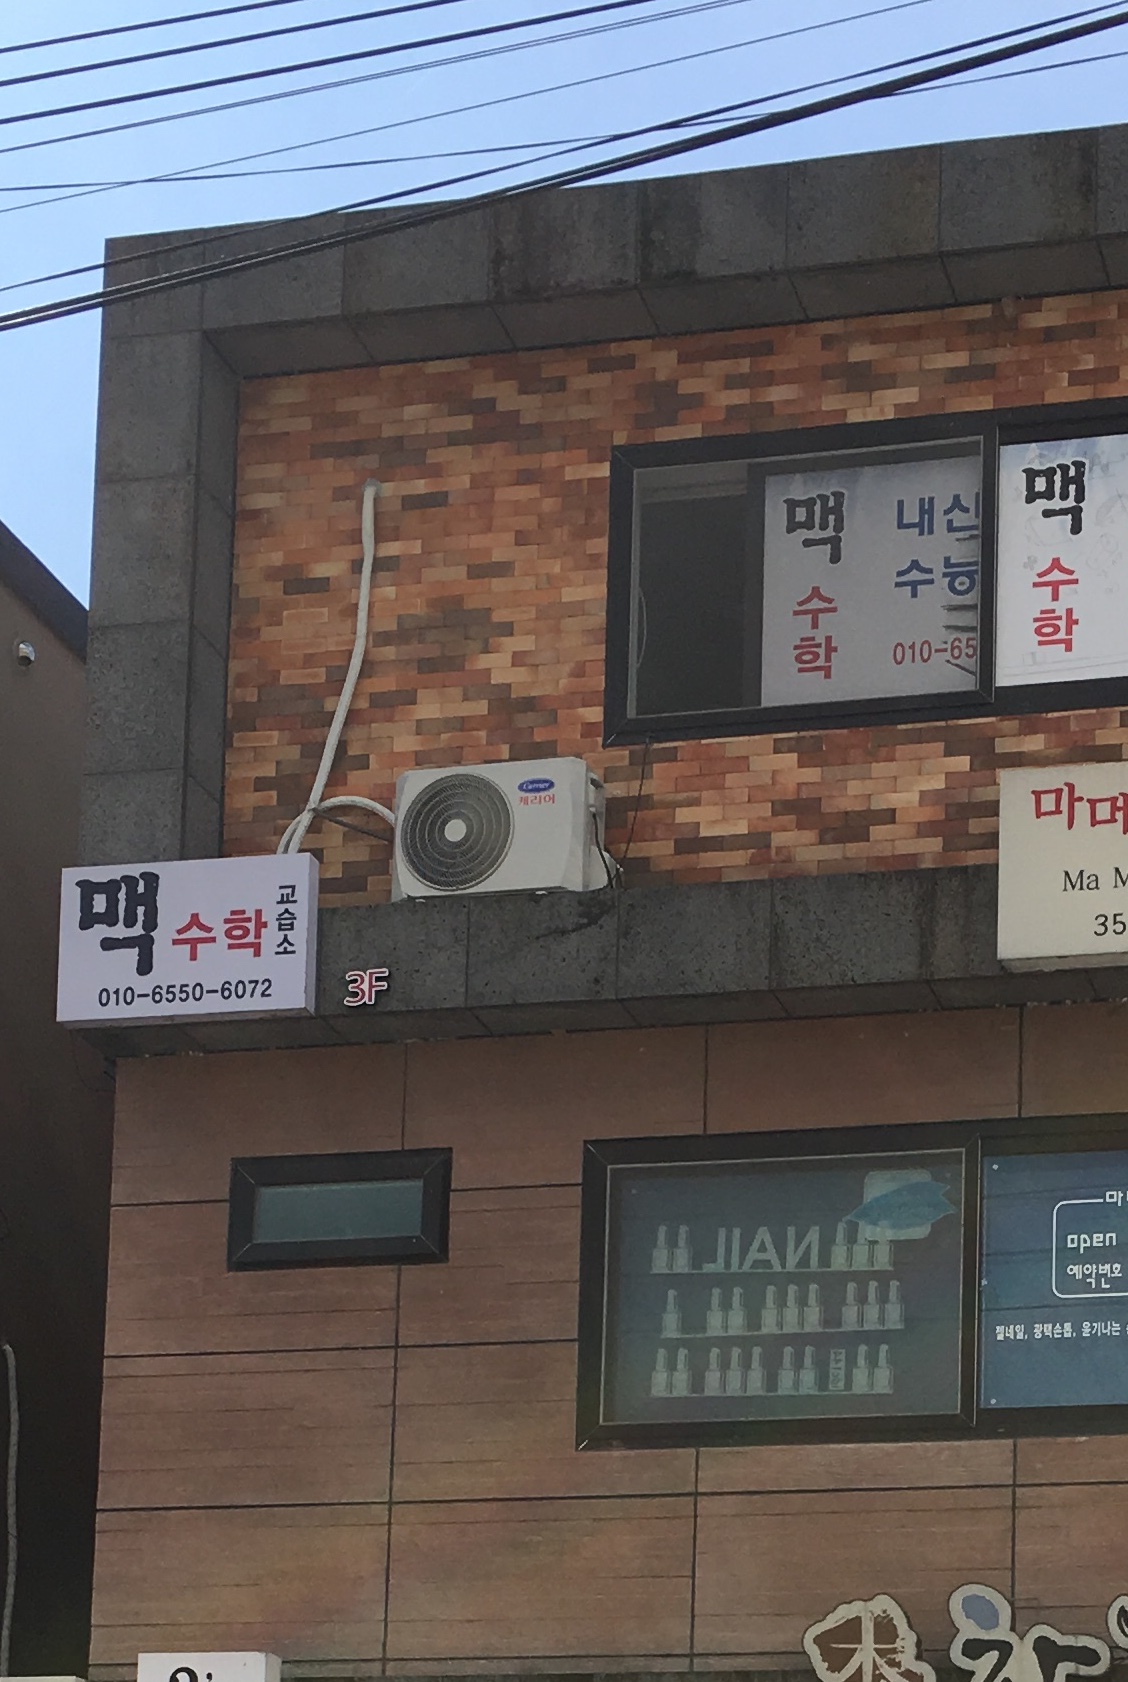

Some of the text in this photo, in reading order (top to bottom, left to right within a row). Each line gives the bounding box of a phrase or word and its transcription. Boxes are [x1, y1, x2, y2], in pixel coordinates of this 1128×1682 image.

[783, 490, 847, 564] 맥
[895, 493, 979, 537] 내신
[1021, 460, 1088, 536] 맥
[893, 556, 979, 599] 수능
[1032, 556, 1080, 654] 수학
[792, 585, 839, 680] 수학
[1062, 868, 1100, 893] Ma
[75, 871, 269, 976] 맥 수학
[274, 884, 299, 957] 교습소
[98, 978, 273, 1008] 010-6550-6072
[344, 968, 389, 1006] 3F
[1066, 1262, 1123, 1289] 예약번호
